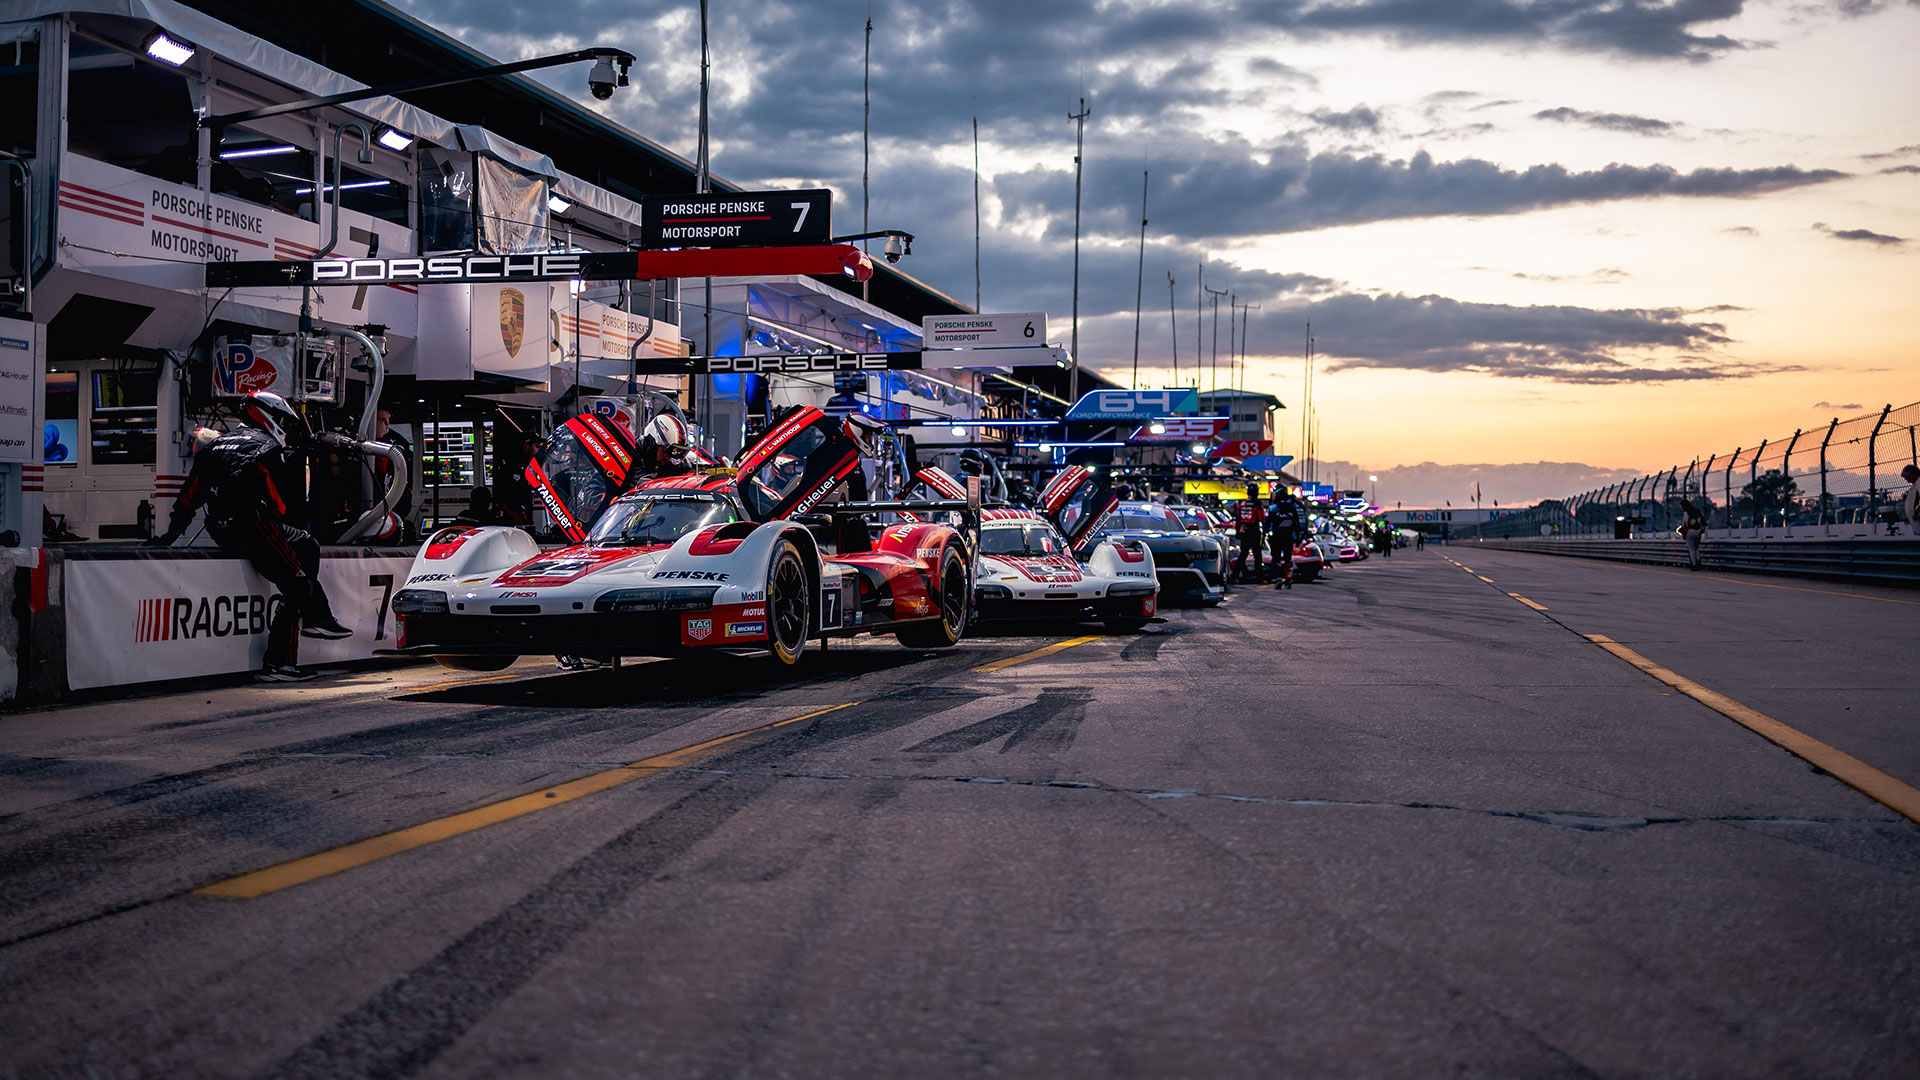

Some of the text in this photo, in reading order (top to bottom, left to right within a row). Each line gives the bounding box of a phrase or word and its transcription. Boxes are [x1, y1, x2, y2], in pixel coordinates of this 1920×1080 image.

[152, 190, 262, 234] PORSCHE PENSKE
[663, 201, 765, 215] PORSCHE PENSKE
[791, 202, 811, 233] 7
[662, 226, 741, 239] MOTORSPORT
[151, 229, 239, 262] MOTORSPORT
[313, 256, 580, 281] PORSCHE
[602, 314, 627, 332] PORSCHE
[935, 320, 993, 329] PORSCHE PENSKE
[1023, 321, 1035, 338] 6
[935, 334, 980, 342] MOTORSPORT
[313, 351, 328, 379] 7
[707, 354, 887, 373] PORSCHE
[239, 371, 278, 389] Racing
[1099, 392, 1170, 412] 64
[1239, 442, 1260, 456] 93
[1264, 457, 1281, 468] 60
[786, 475, 837, 520] AGHeuer
[537, 482, 572, 529] TAGHeuer
[1406, 511, 1439, 521] Mobil
[916, 548, 940, 558] PENSKE
[405, 573, 455, 586] PENSKE
[652, 571, 730, 582] PENSKE
[741, 592, 758, 602] Mobil
[369, 574, 394, 641] 7
[743, 608, 765, 617] MOTUL
[828, 593, 836, 623] 7
[691, 620, 711, 628] TAG
[736, 624, 763, 633] MICHELIN
[689, 628, 711, 640] HEUER
